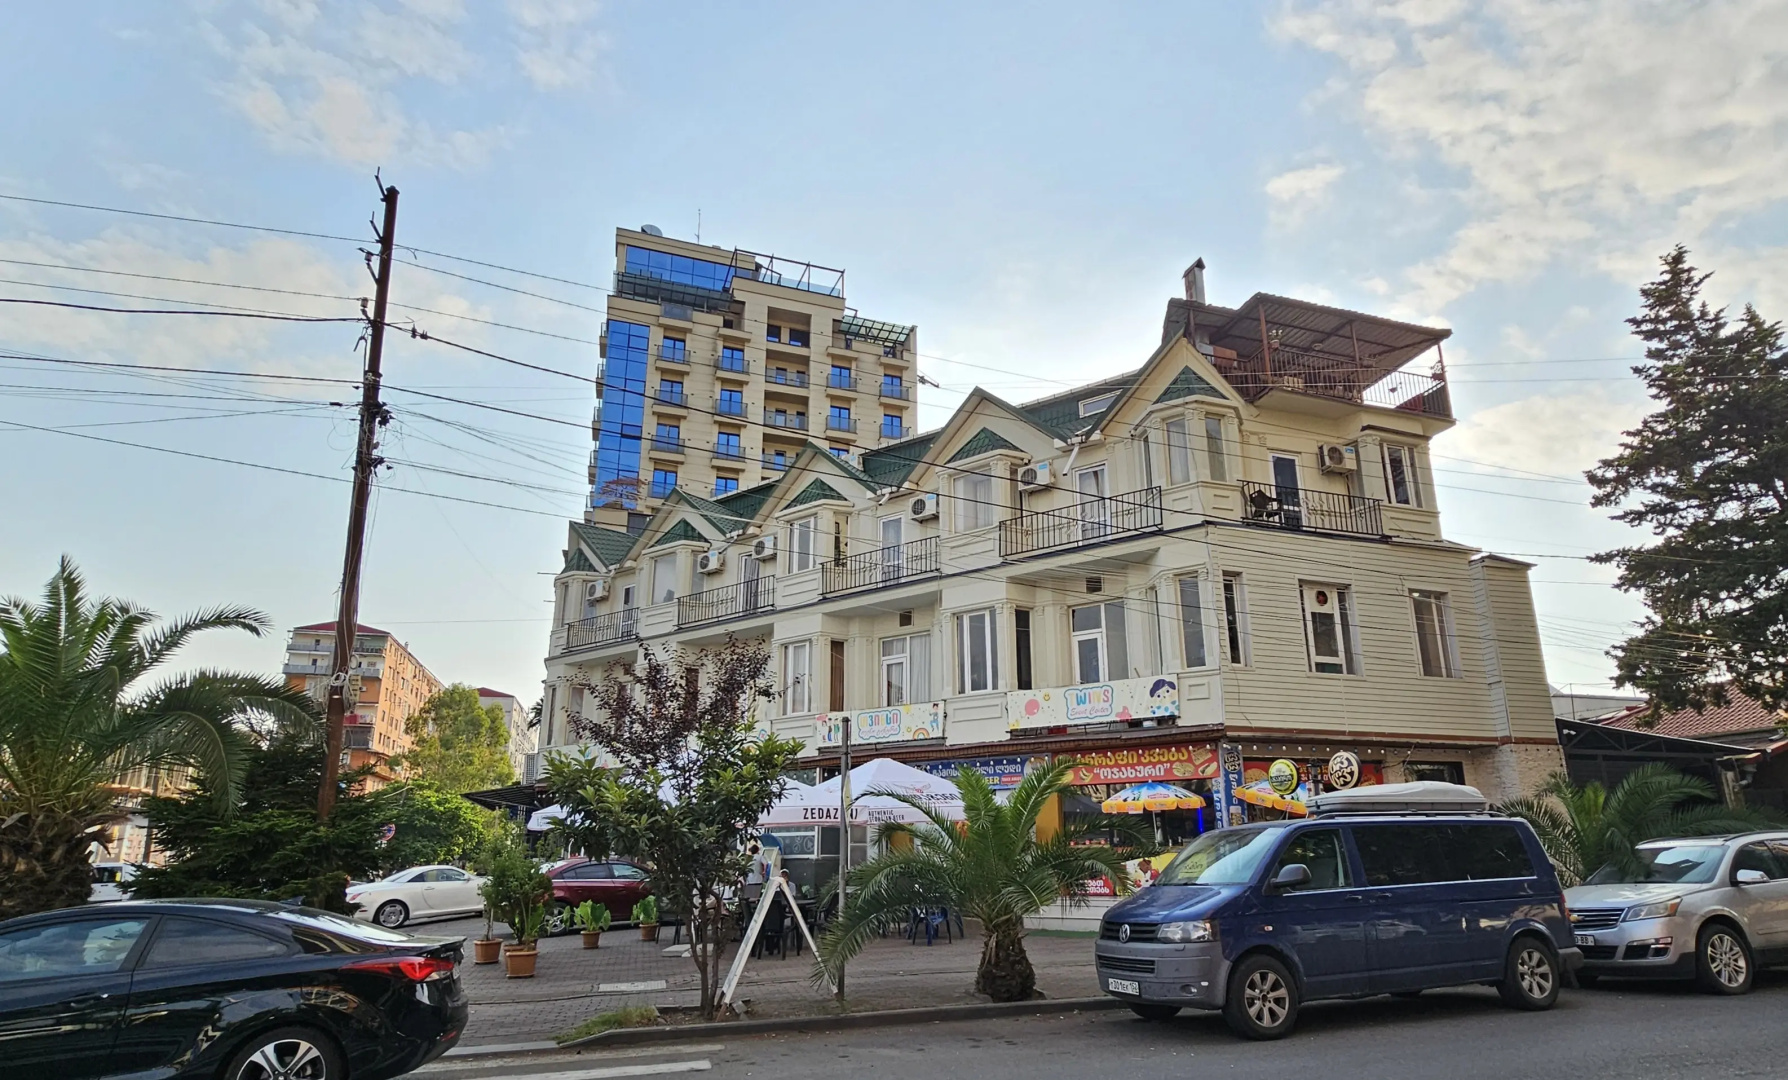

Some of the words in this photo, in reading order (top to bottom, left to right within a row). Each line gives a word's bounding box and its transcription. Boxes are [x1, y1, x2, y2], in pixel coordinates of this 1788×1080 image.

[1067, 689, 1110, 706] TWINS
[1070, 707, 1088, 717] Event
[1089, 705, 1109, 716] Center
[1140, 747, 1189, 763] კვება
[984, 775, 1000, 785] EER
[803, 807, 858, 820] ZEDAZNI
